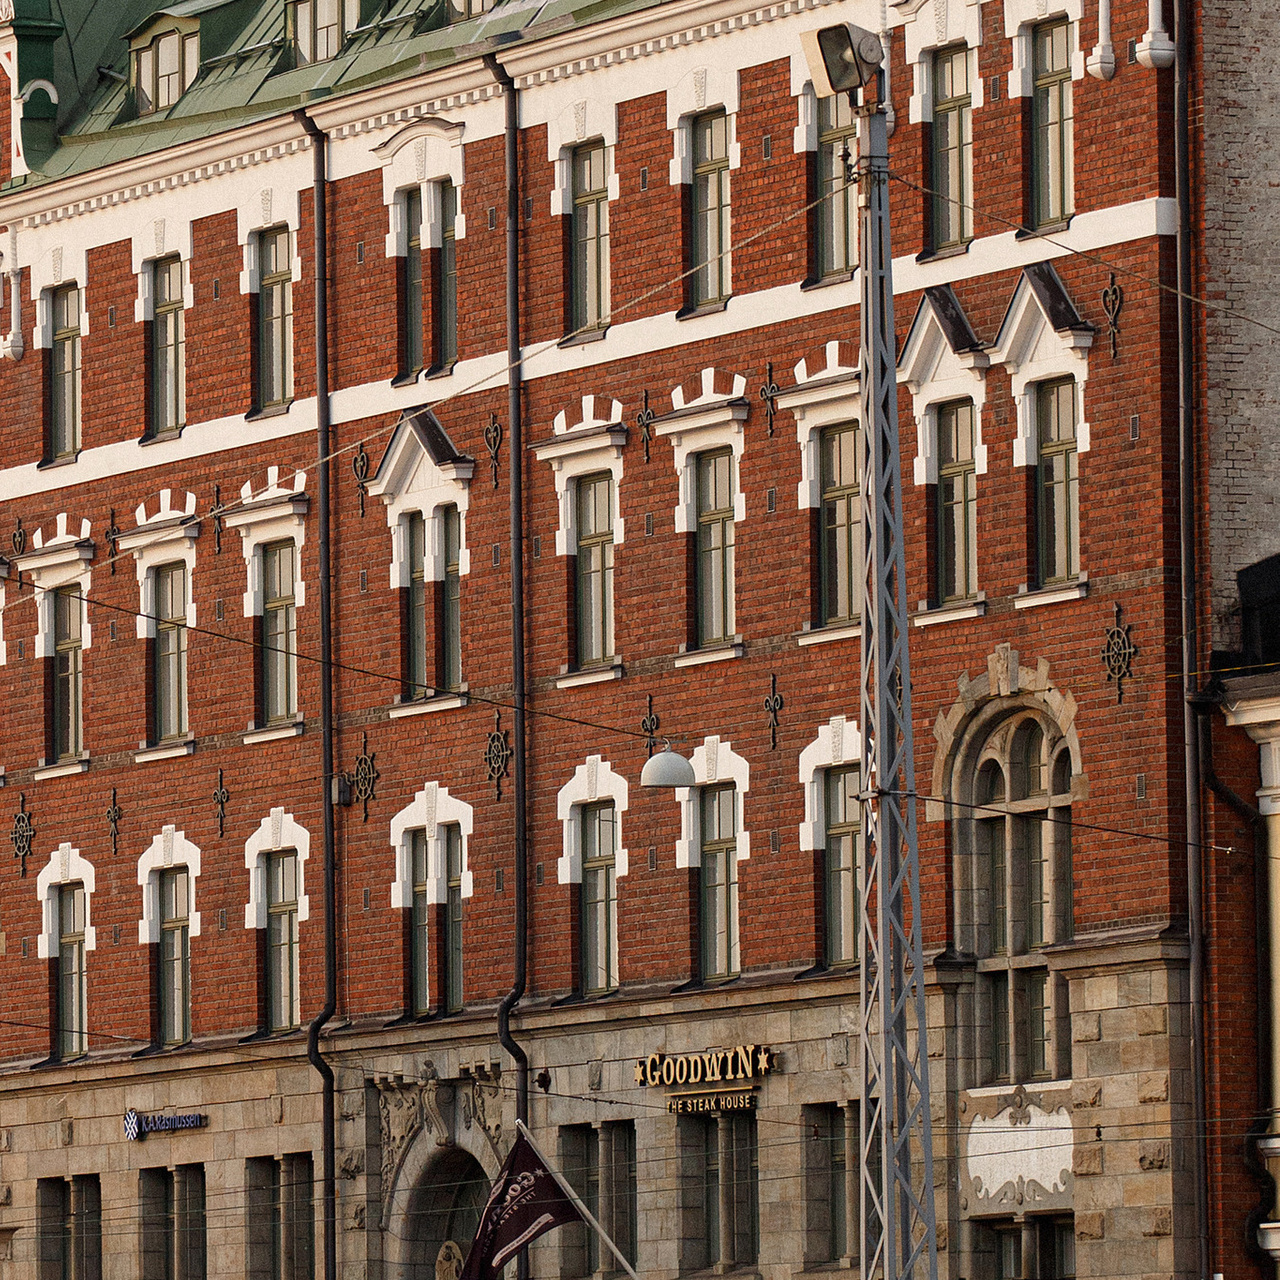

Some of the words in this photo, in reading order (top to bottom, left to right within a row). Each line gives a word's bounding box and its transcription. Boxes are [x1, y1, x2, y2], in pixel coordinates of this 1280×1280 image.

[646, 1045, 755, 1087] GOODWIN
[667, 1100, 683, 1113] THE
[687, 1097, 717, 1112] STEAK
[720, 1095, 751, 1110] HOUSE
